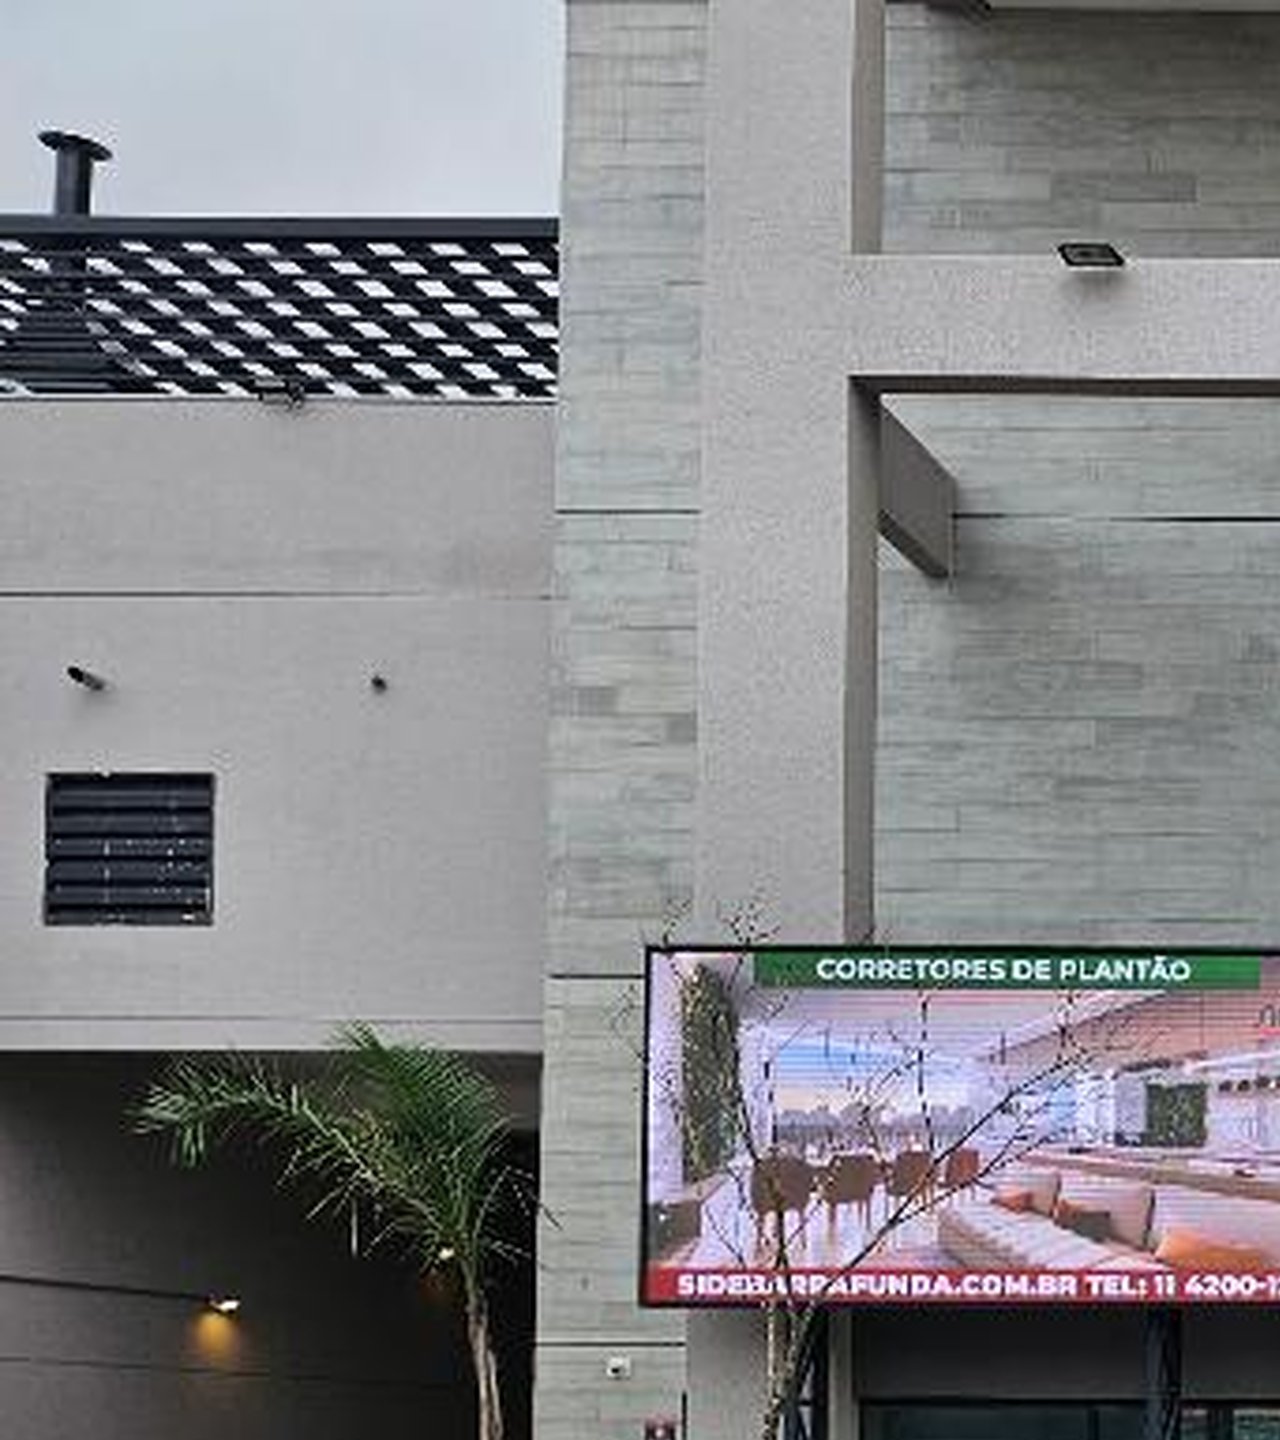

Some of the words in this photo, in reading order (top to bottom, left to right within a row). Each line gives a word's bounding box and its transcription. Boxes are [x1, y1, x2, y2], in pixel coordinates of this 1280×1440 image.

[816, 958, 1007, 982] CORRETORES
[1011, 959, 1052, 981] DE
[1059, 955, 1192, 982] PLANTÃO
[1084, 1273, 1147, 1296] TEL:
[1154, 1273, 1176, 1296] 11
